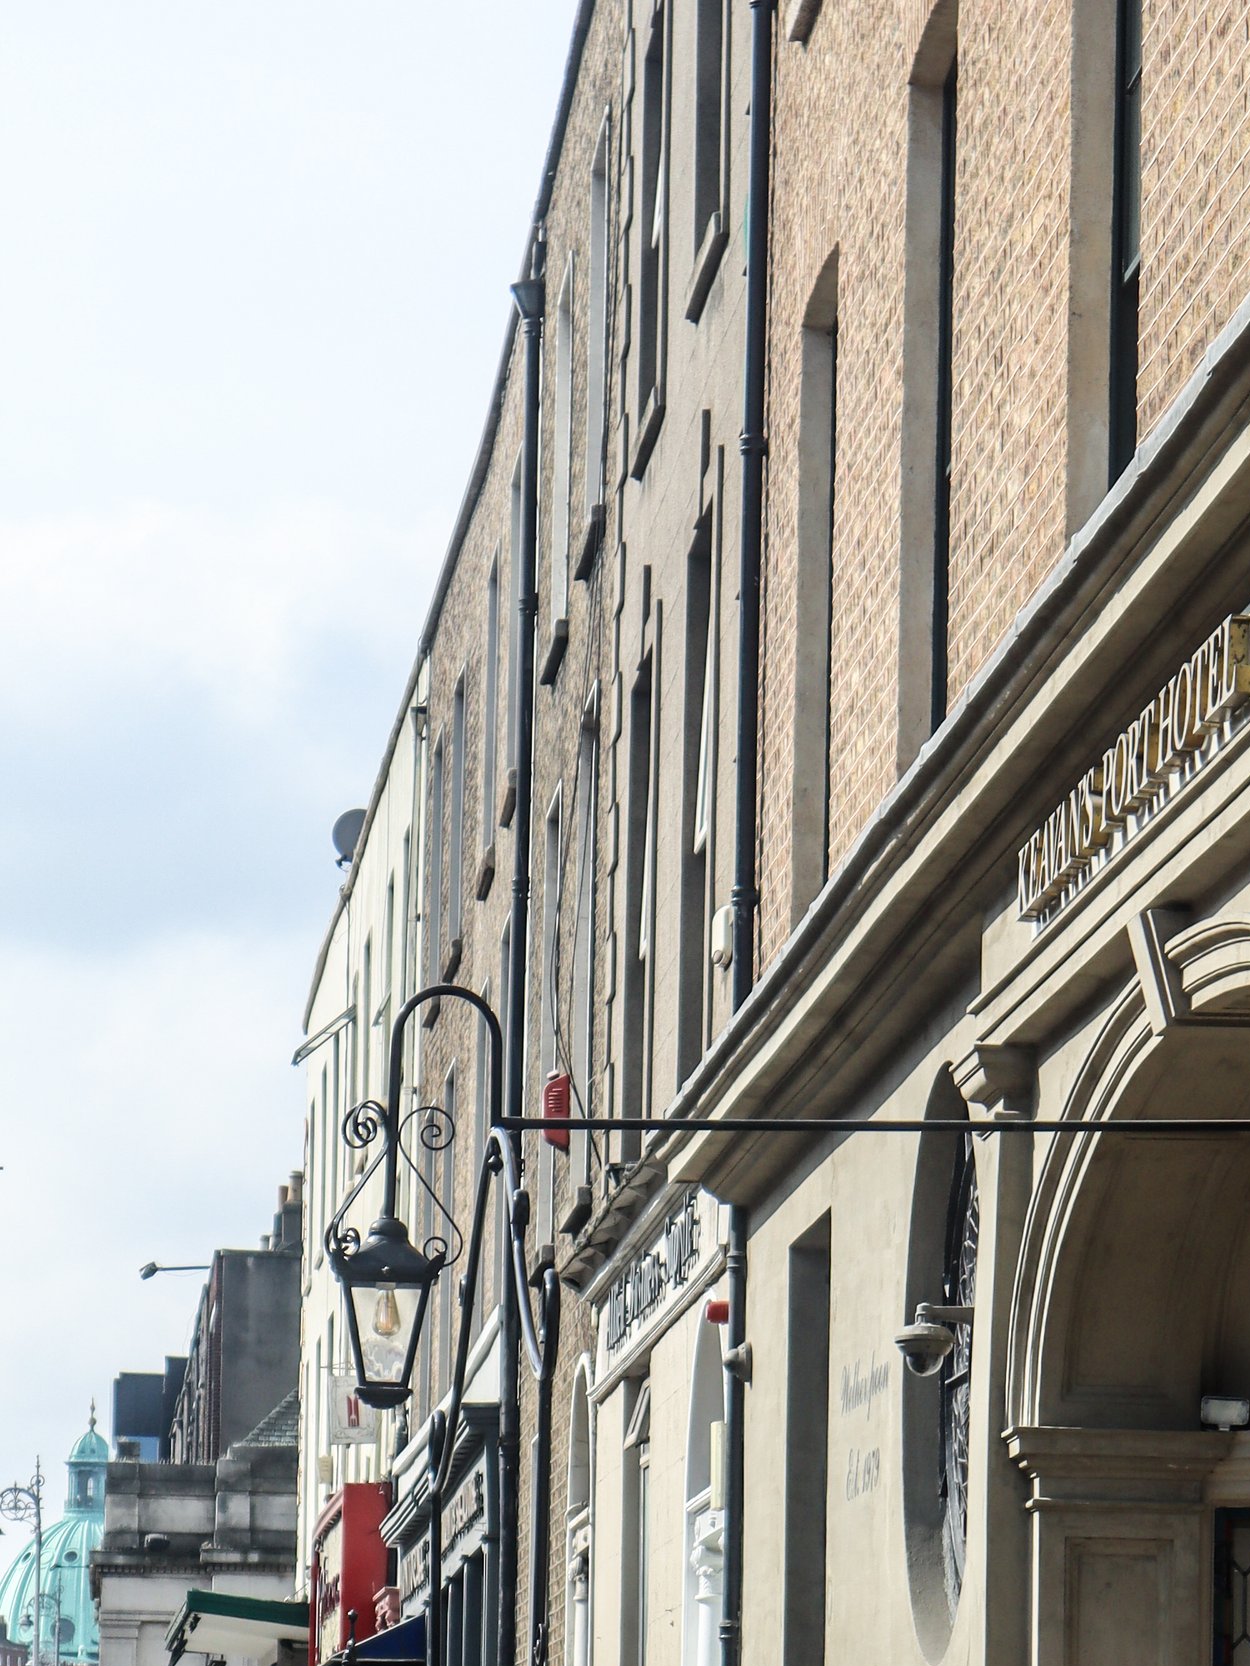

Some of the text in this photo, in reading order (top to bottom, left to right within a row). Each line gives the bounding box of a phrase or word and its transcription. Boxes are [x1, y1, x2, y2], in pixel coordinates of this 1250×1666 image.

[1017, 613, 1250, 922] KEAVAN'S PORT HOTEL
